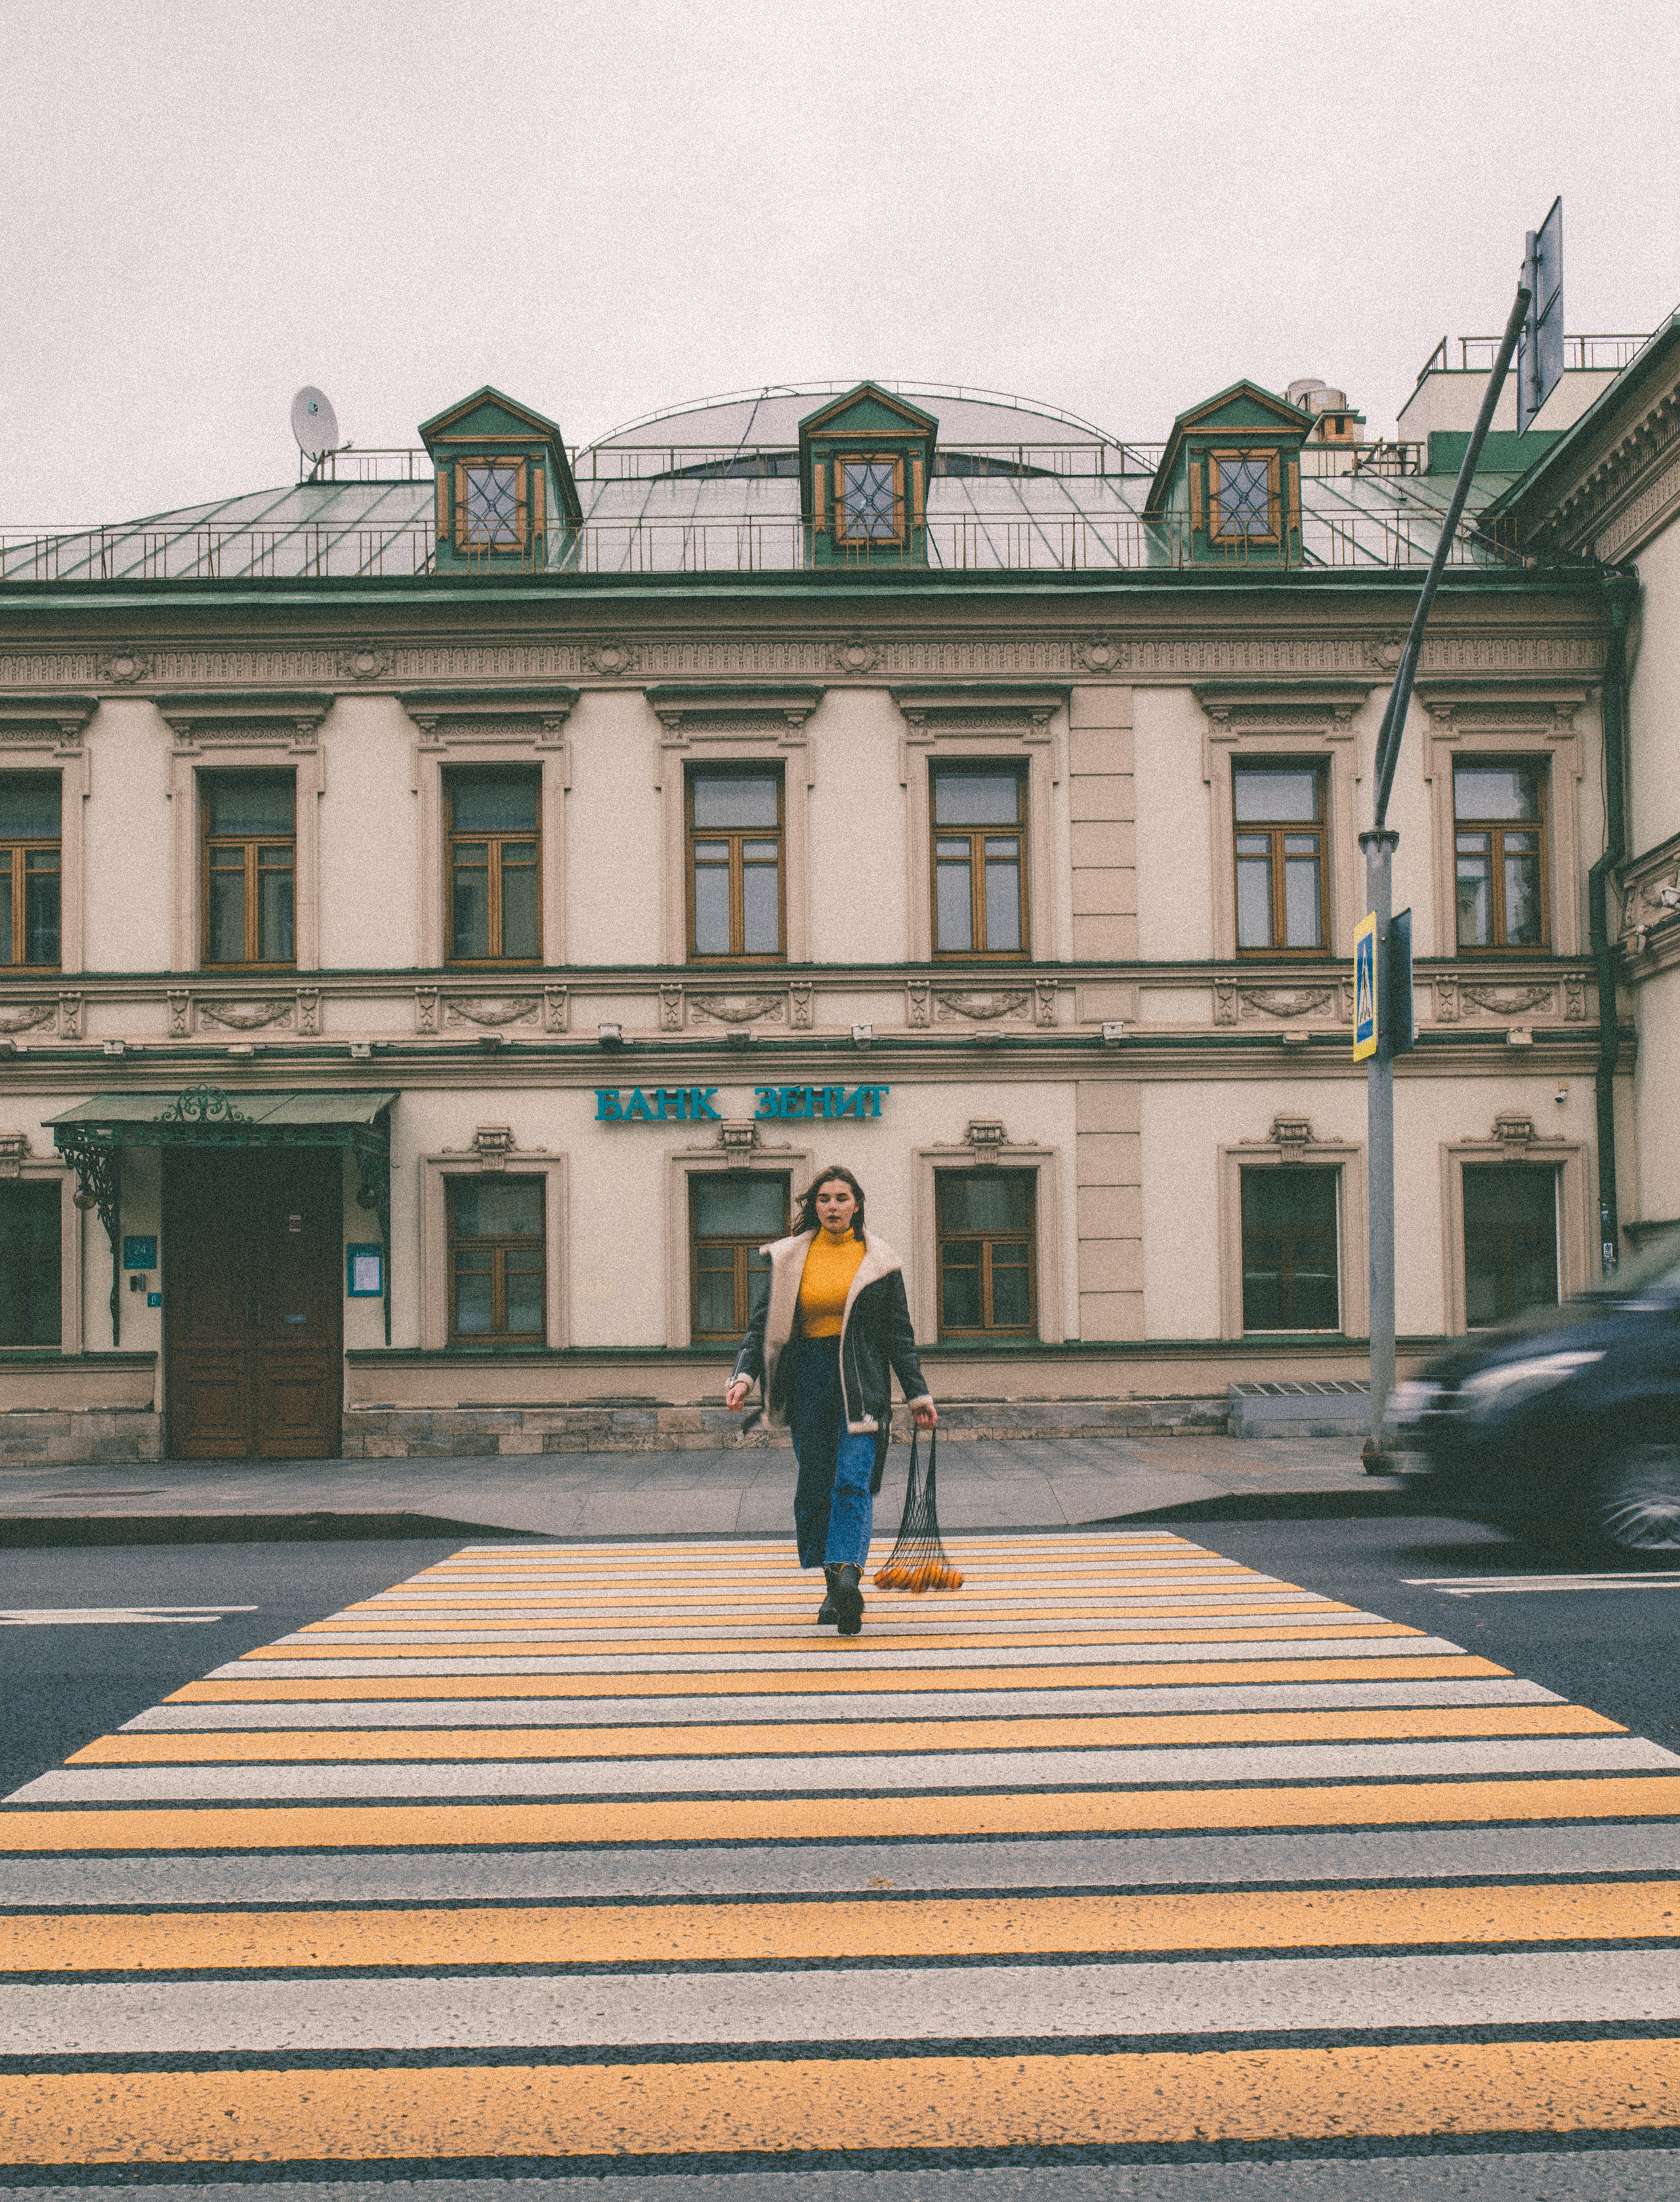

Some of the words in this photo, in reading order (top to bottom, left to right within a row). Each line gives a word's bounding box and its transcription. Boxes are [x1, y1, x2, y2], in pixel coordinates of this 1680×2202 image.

[595, 1086, 722, 1120] БАНК
[755, 1084, 890, 1118] ЗЕНИТ
[133, 1244, 146, 1254] 24
